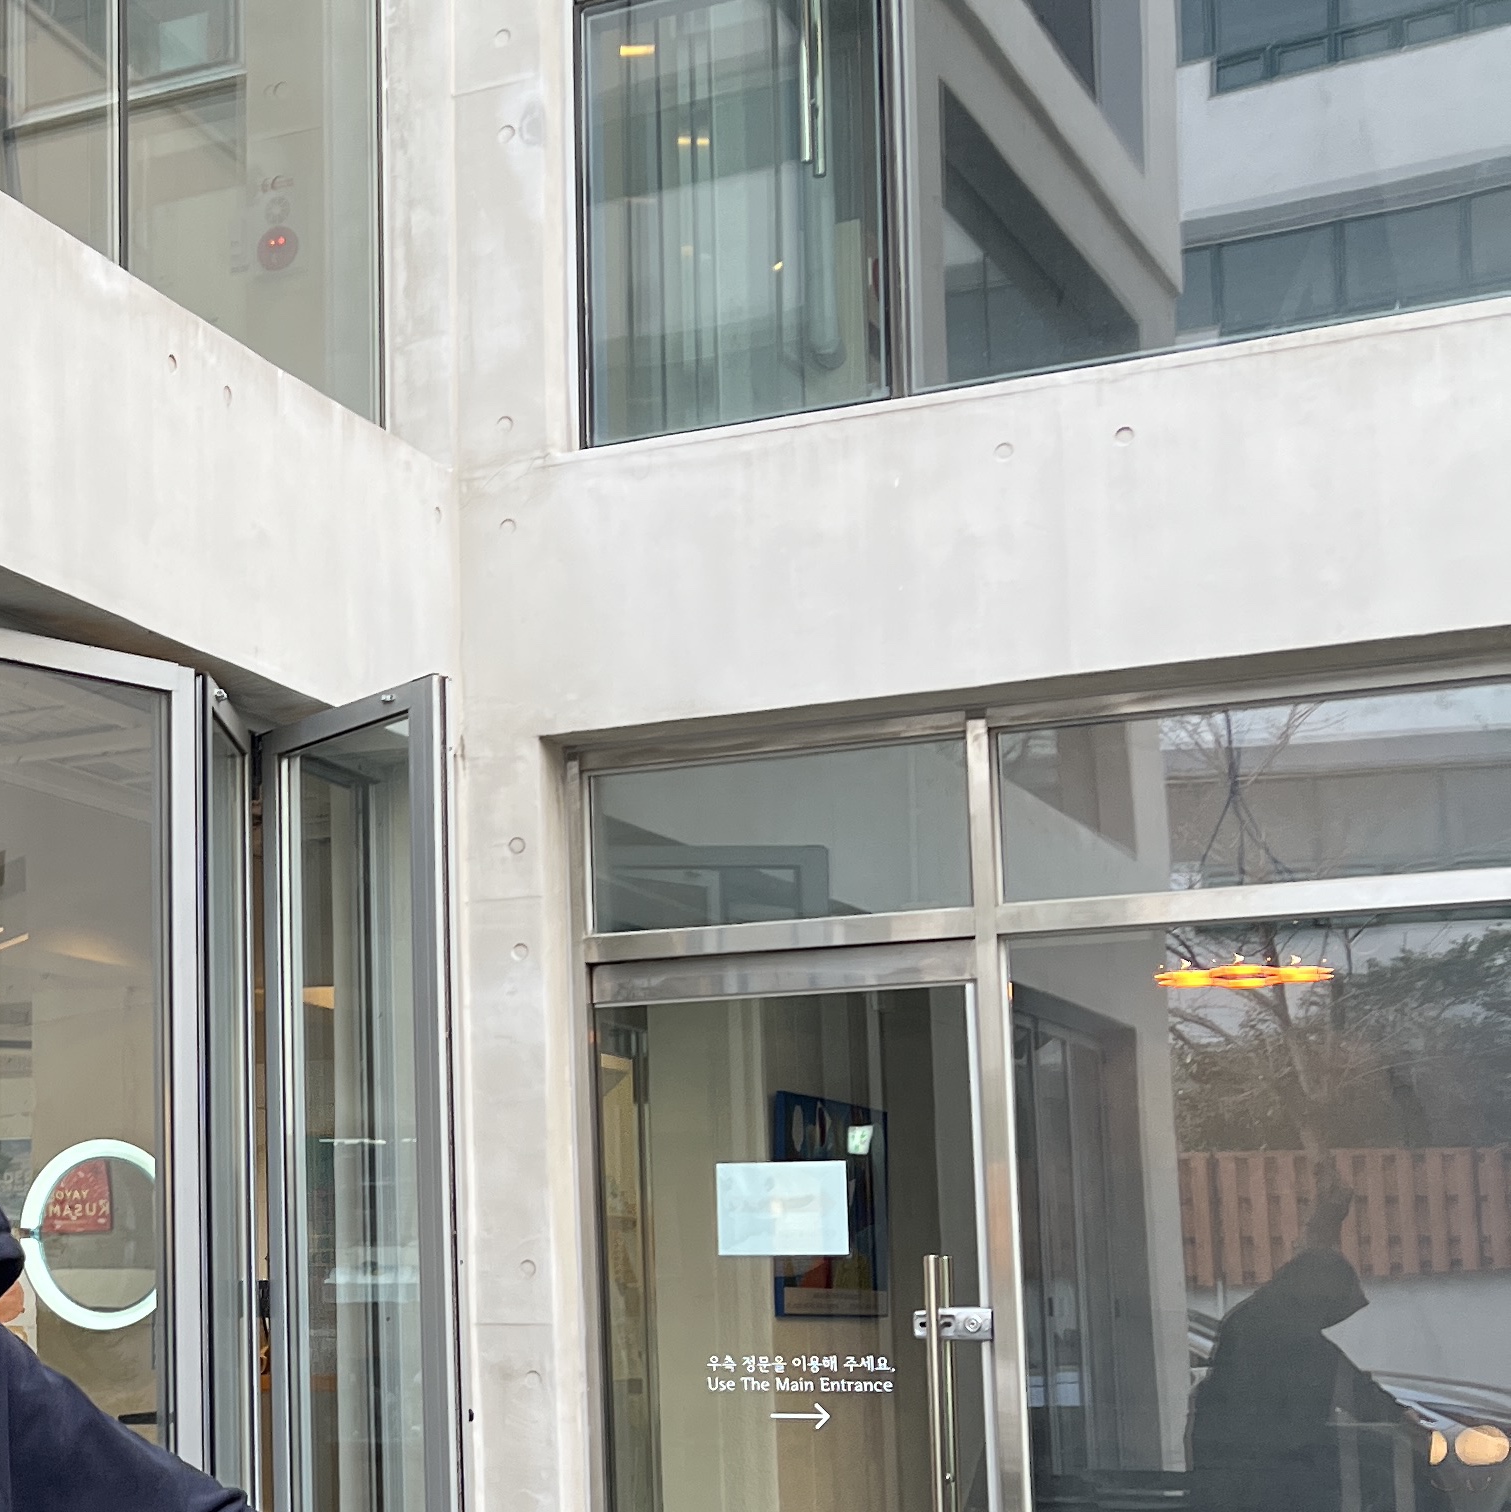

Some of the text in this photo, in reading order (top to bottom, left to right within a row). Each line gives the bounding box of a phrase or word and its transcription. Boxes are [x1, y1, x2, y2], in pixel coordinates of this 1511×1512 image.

[706, 1354, 896, 1374] 우측 정문을 이용해 주세요.
[706, 1376, 894, 1393] Use The Main Entrance
